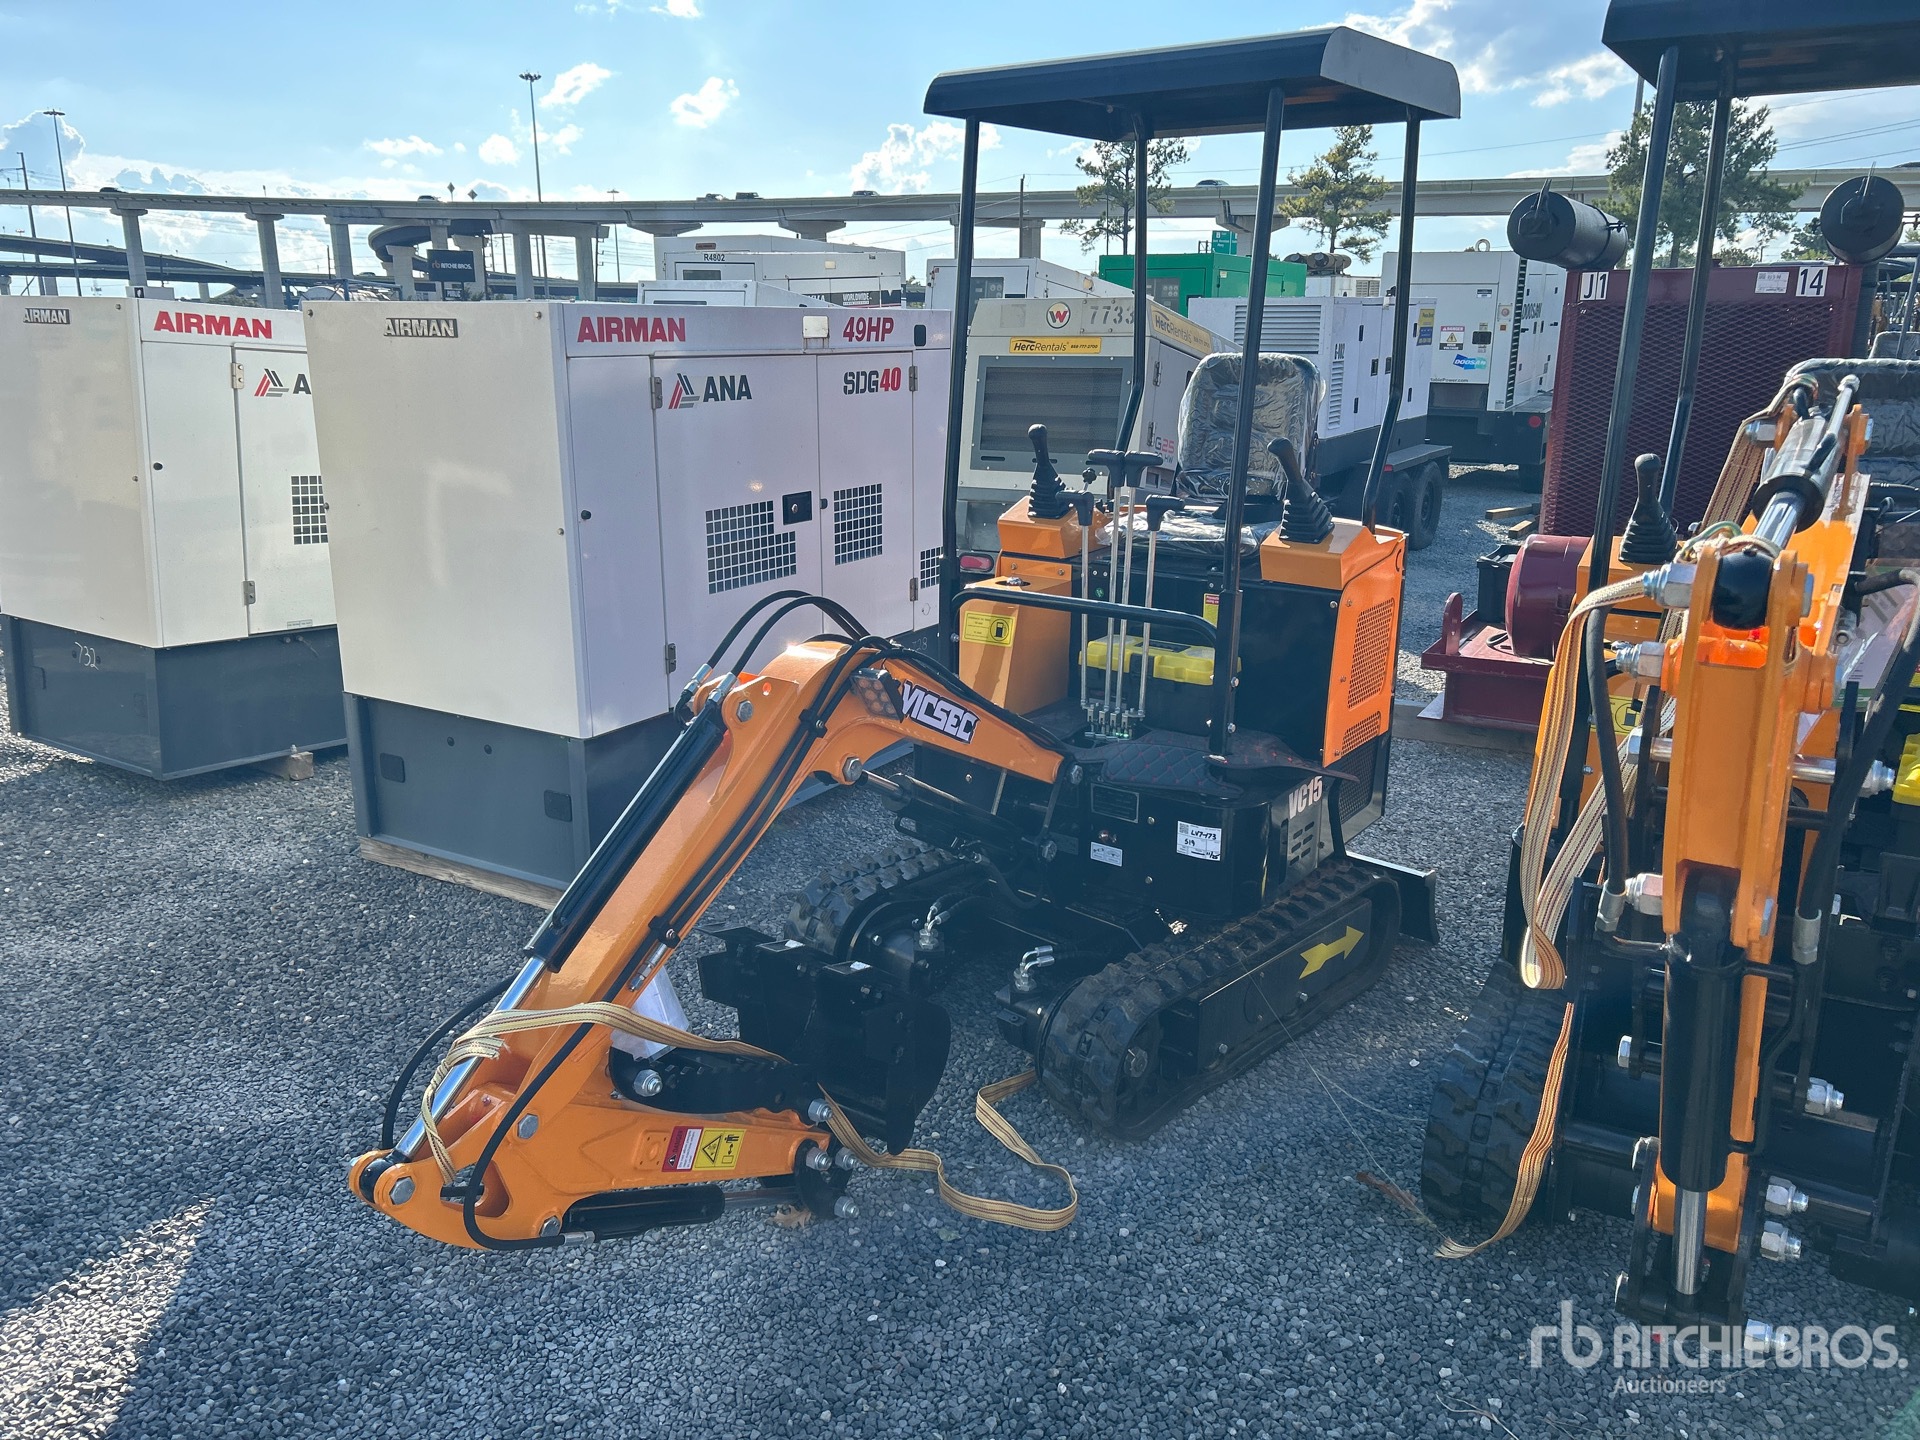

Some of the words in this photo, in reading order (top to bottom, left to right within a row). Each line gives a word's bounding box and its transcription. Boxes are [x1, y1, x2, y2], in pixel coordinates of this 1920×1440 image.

[704, 253, 726, 262] R4802
[1800, 268, 1824, 296] 14
[23, 308, 69, 324] AIRMAN
[153, 310, 273, 340] AIRMAN
[383, 318, 456, 337] AIRMAN
[576, 316, 687, 343] AIRMAN
[843, 316, 895, 342] 49HP
[1013, 341, 1067, 352] HercRentals
[703, 374, 753, 403] ANA
[843, 366, 902, 396] SDG40
[74, 641, 99, 671] 732
[902, 680, 980, 743] VICSEC
[1288, 775, 1323, 820] VC15
